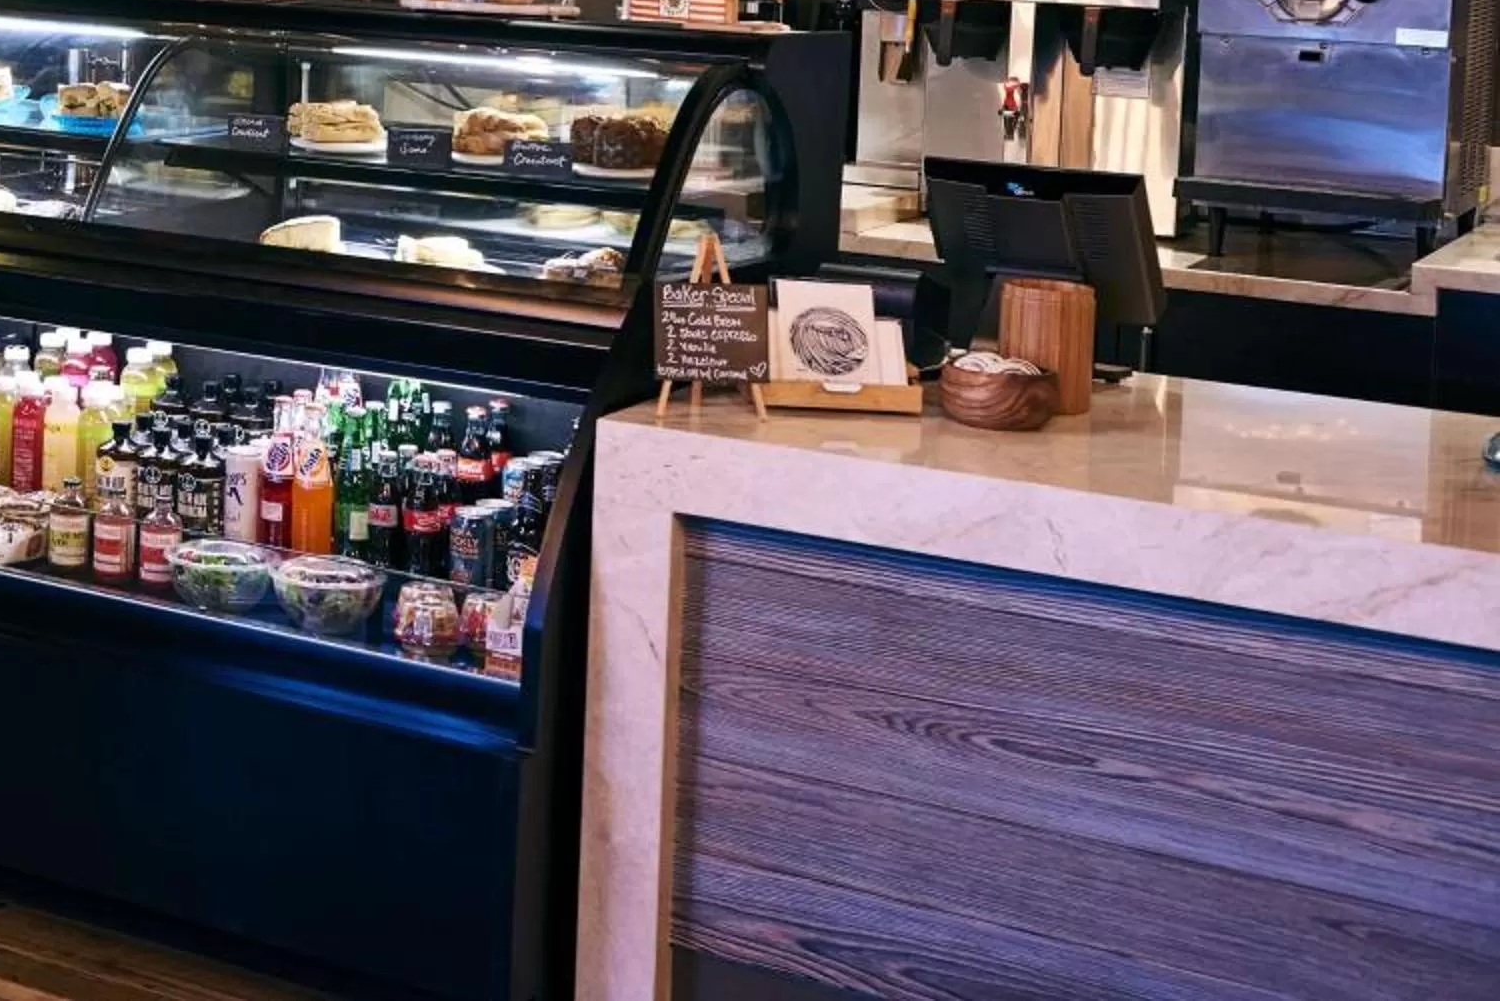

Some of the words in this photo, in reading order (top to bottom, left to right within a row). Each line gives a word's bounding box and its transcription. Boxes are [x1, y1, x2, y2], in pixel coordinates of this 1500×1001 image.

[666, 325, 676, 338] 2
[666, 339, 678, 351] 2
[667, 352, 678, 364] 2
[300, 447, 323, 476] Fanta
